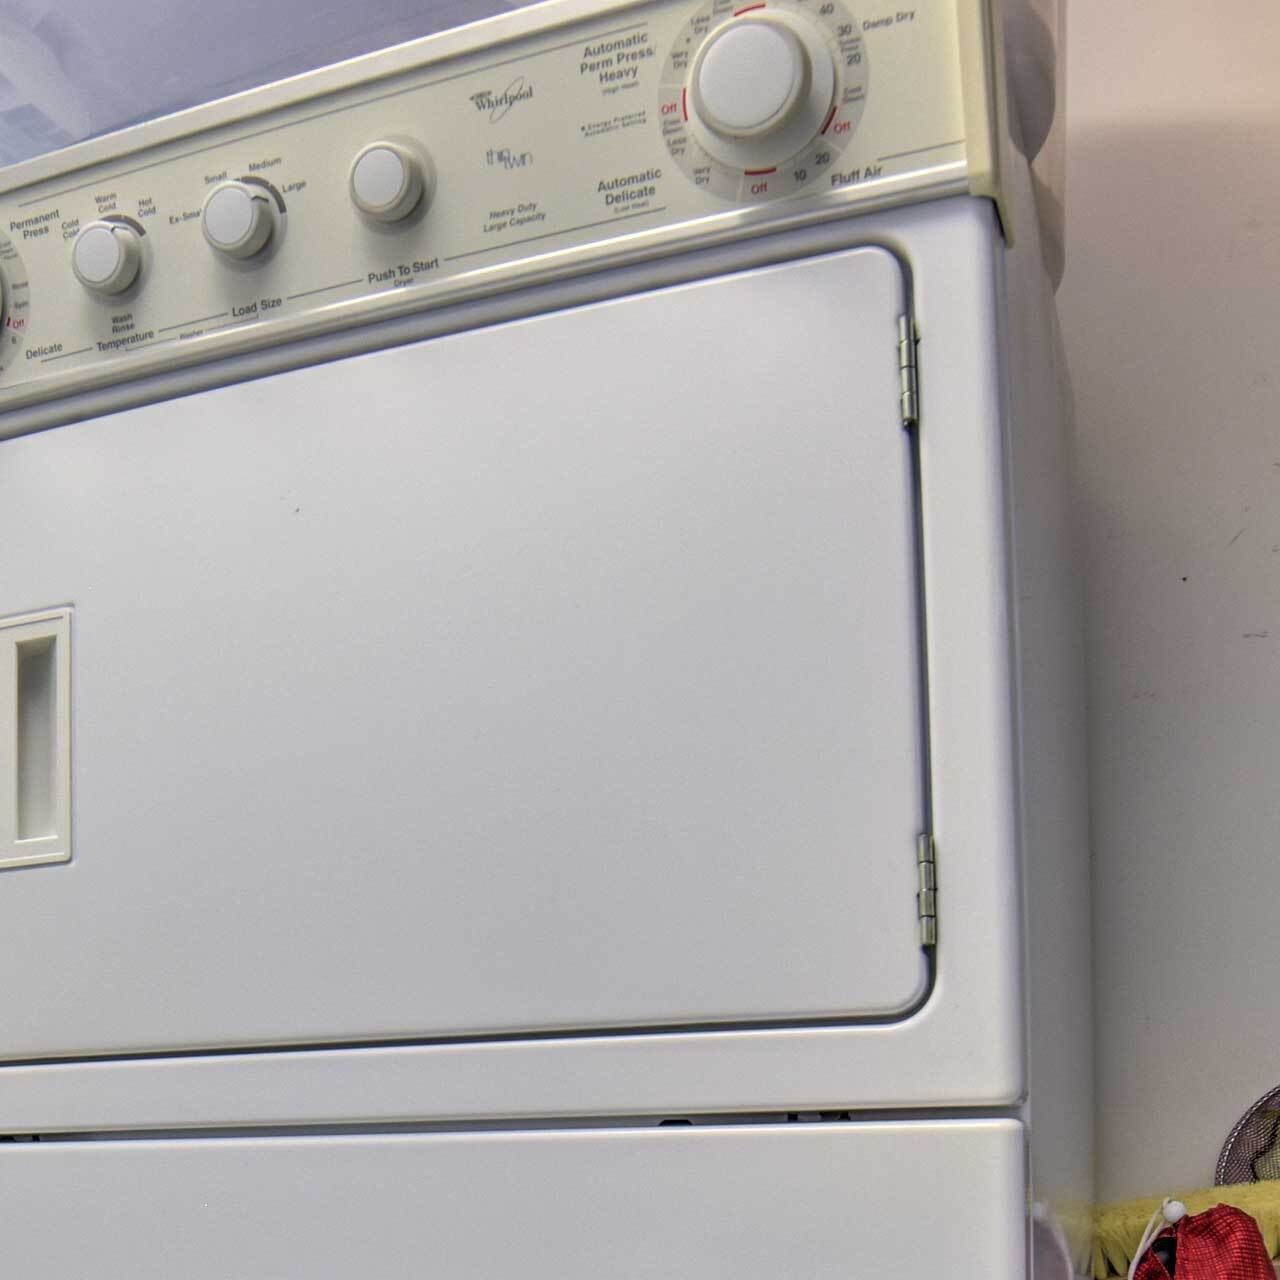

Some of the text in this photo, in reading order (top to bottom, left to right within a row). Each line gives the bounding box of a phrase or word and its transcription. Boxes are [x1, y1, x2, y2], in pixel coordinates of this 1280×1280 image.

[863, 10, 916, 31] Damp Dry
[583, 32, 648, 58] Automatic
[580, 55, 614, 74] Perm
[847, 53, 861, 66] 20
[599, 66, 638, 84] Heavy
[661, 103, 677, 114] Off
[834, 122, 851, 134] Off
[249, 156, 281, 172] Medium
[815, 153, 830, 165] 20
[204, 171, 228, 185] Small
[597, 168, 662, 193] Automatic
[794, 170, 807, 181] 10
[831, 165, 883, 186] Fluff Air
[282, 179, 307, 194] Large
[605, 184, 656, 206] Delicate
[751, 184, 768, 195] Off
[10, 209, 60, 231] Permanent
[169, 208, 202, 225] Ex-Sma
[490, 202, 538, 220] Heavy Duty
[483, 211, 546, 233] Large Capacity
[23, 227, 49, 240] Press
[368, 258, 439, 284] Push To Start
[232, 297, 282, 318] Load Size
[13, 319, 24, 328] Off
[97, 330, 154, 352] Temperature
[26, 342, 63, 360] Delicate
